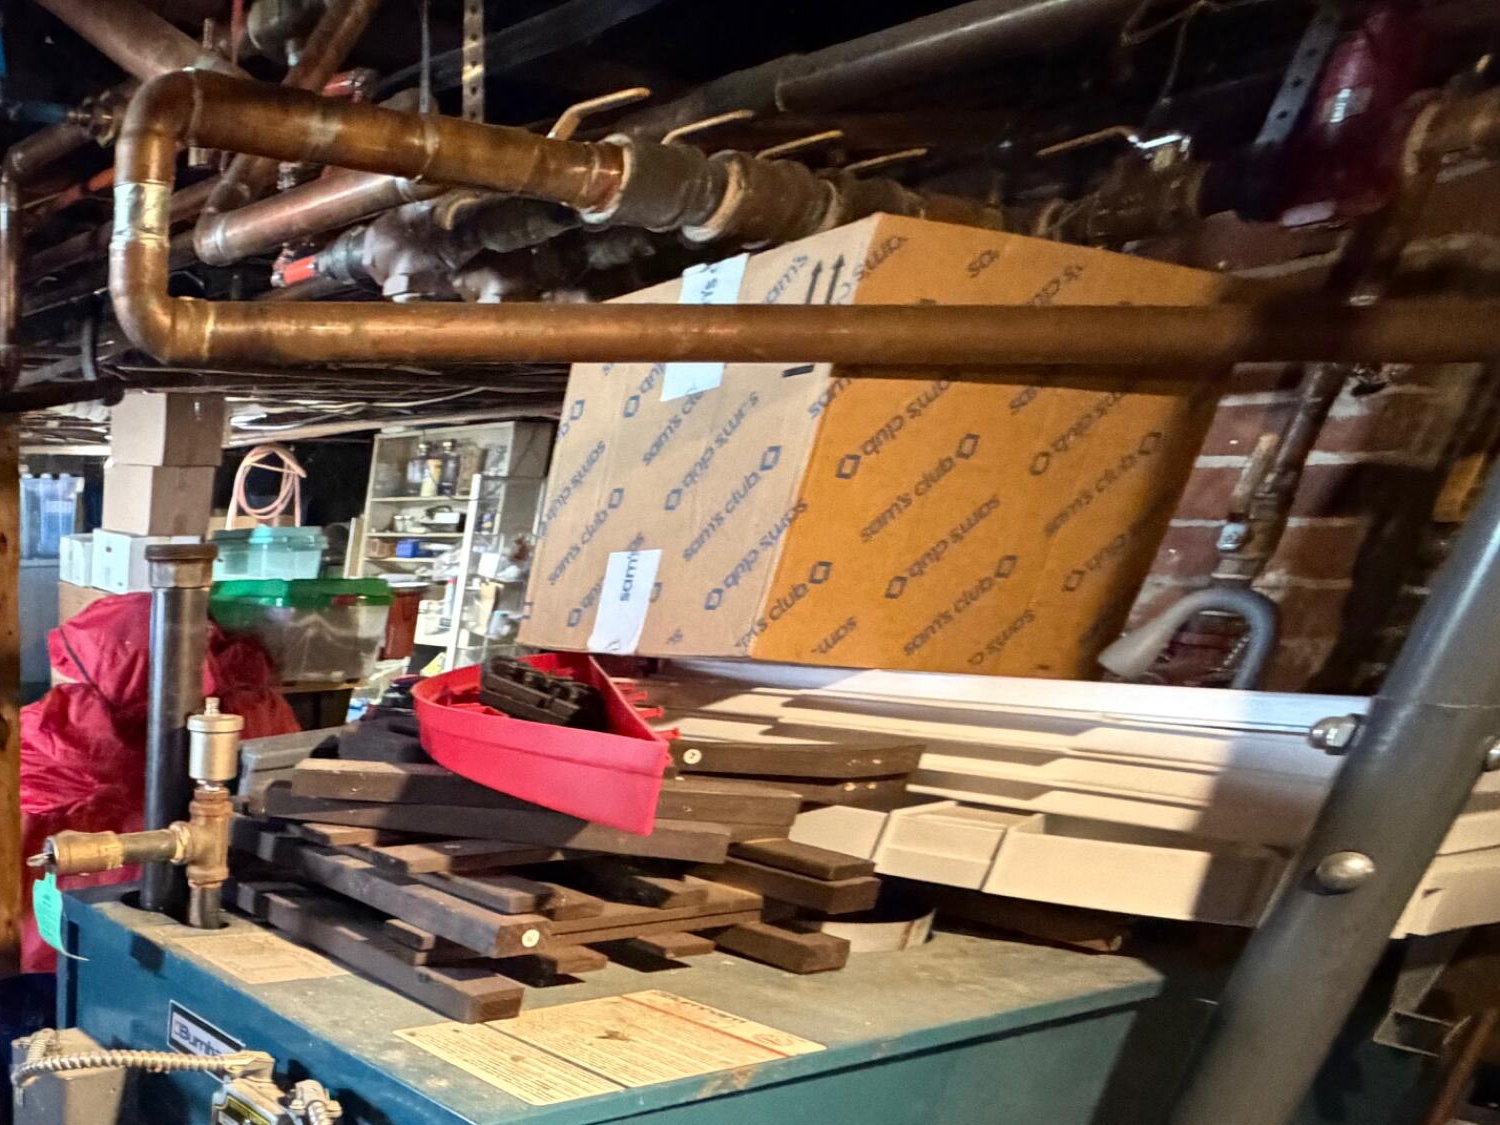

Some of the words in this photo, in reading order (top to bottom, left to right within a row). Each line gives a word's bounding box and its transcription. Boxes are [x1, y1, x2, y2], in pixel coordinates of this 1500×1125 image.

[764, 254, 807, 303] am's
[639, 363, 666, 393] lub
[807, 378, 850, 419] sam
[642, 414, 682, 467] sam's
[862, 415, 904, 455] club
[682, 446, 715, 488] club
[682, 511, 725, 562] sam's
[723, 470, 762, 515] club
[860, 492, 913, 543] sam's
[914, 456, 956, 497] club
[950, 493, 999, 544] sam's
[549, 544, 582, 587] sam's
[581, 508, 609, 546] club
[723, 548, 760, 588] club
[908, 539, 949, 577] club
[768, 582, 809, 621] club
[904, 610, 953, 656] sam's
[953, 575, 996, 613] club
